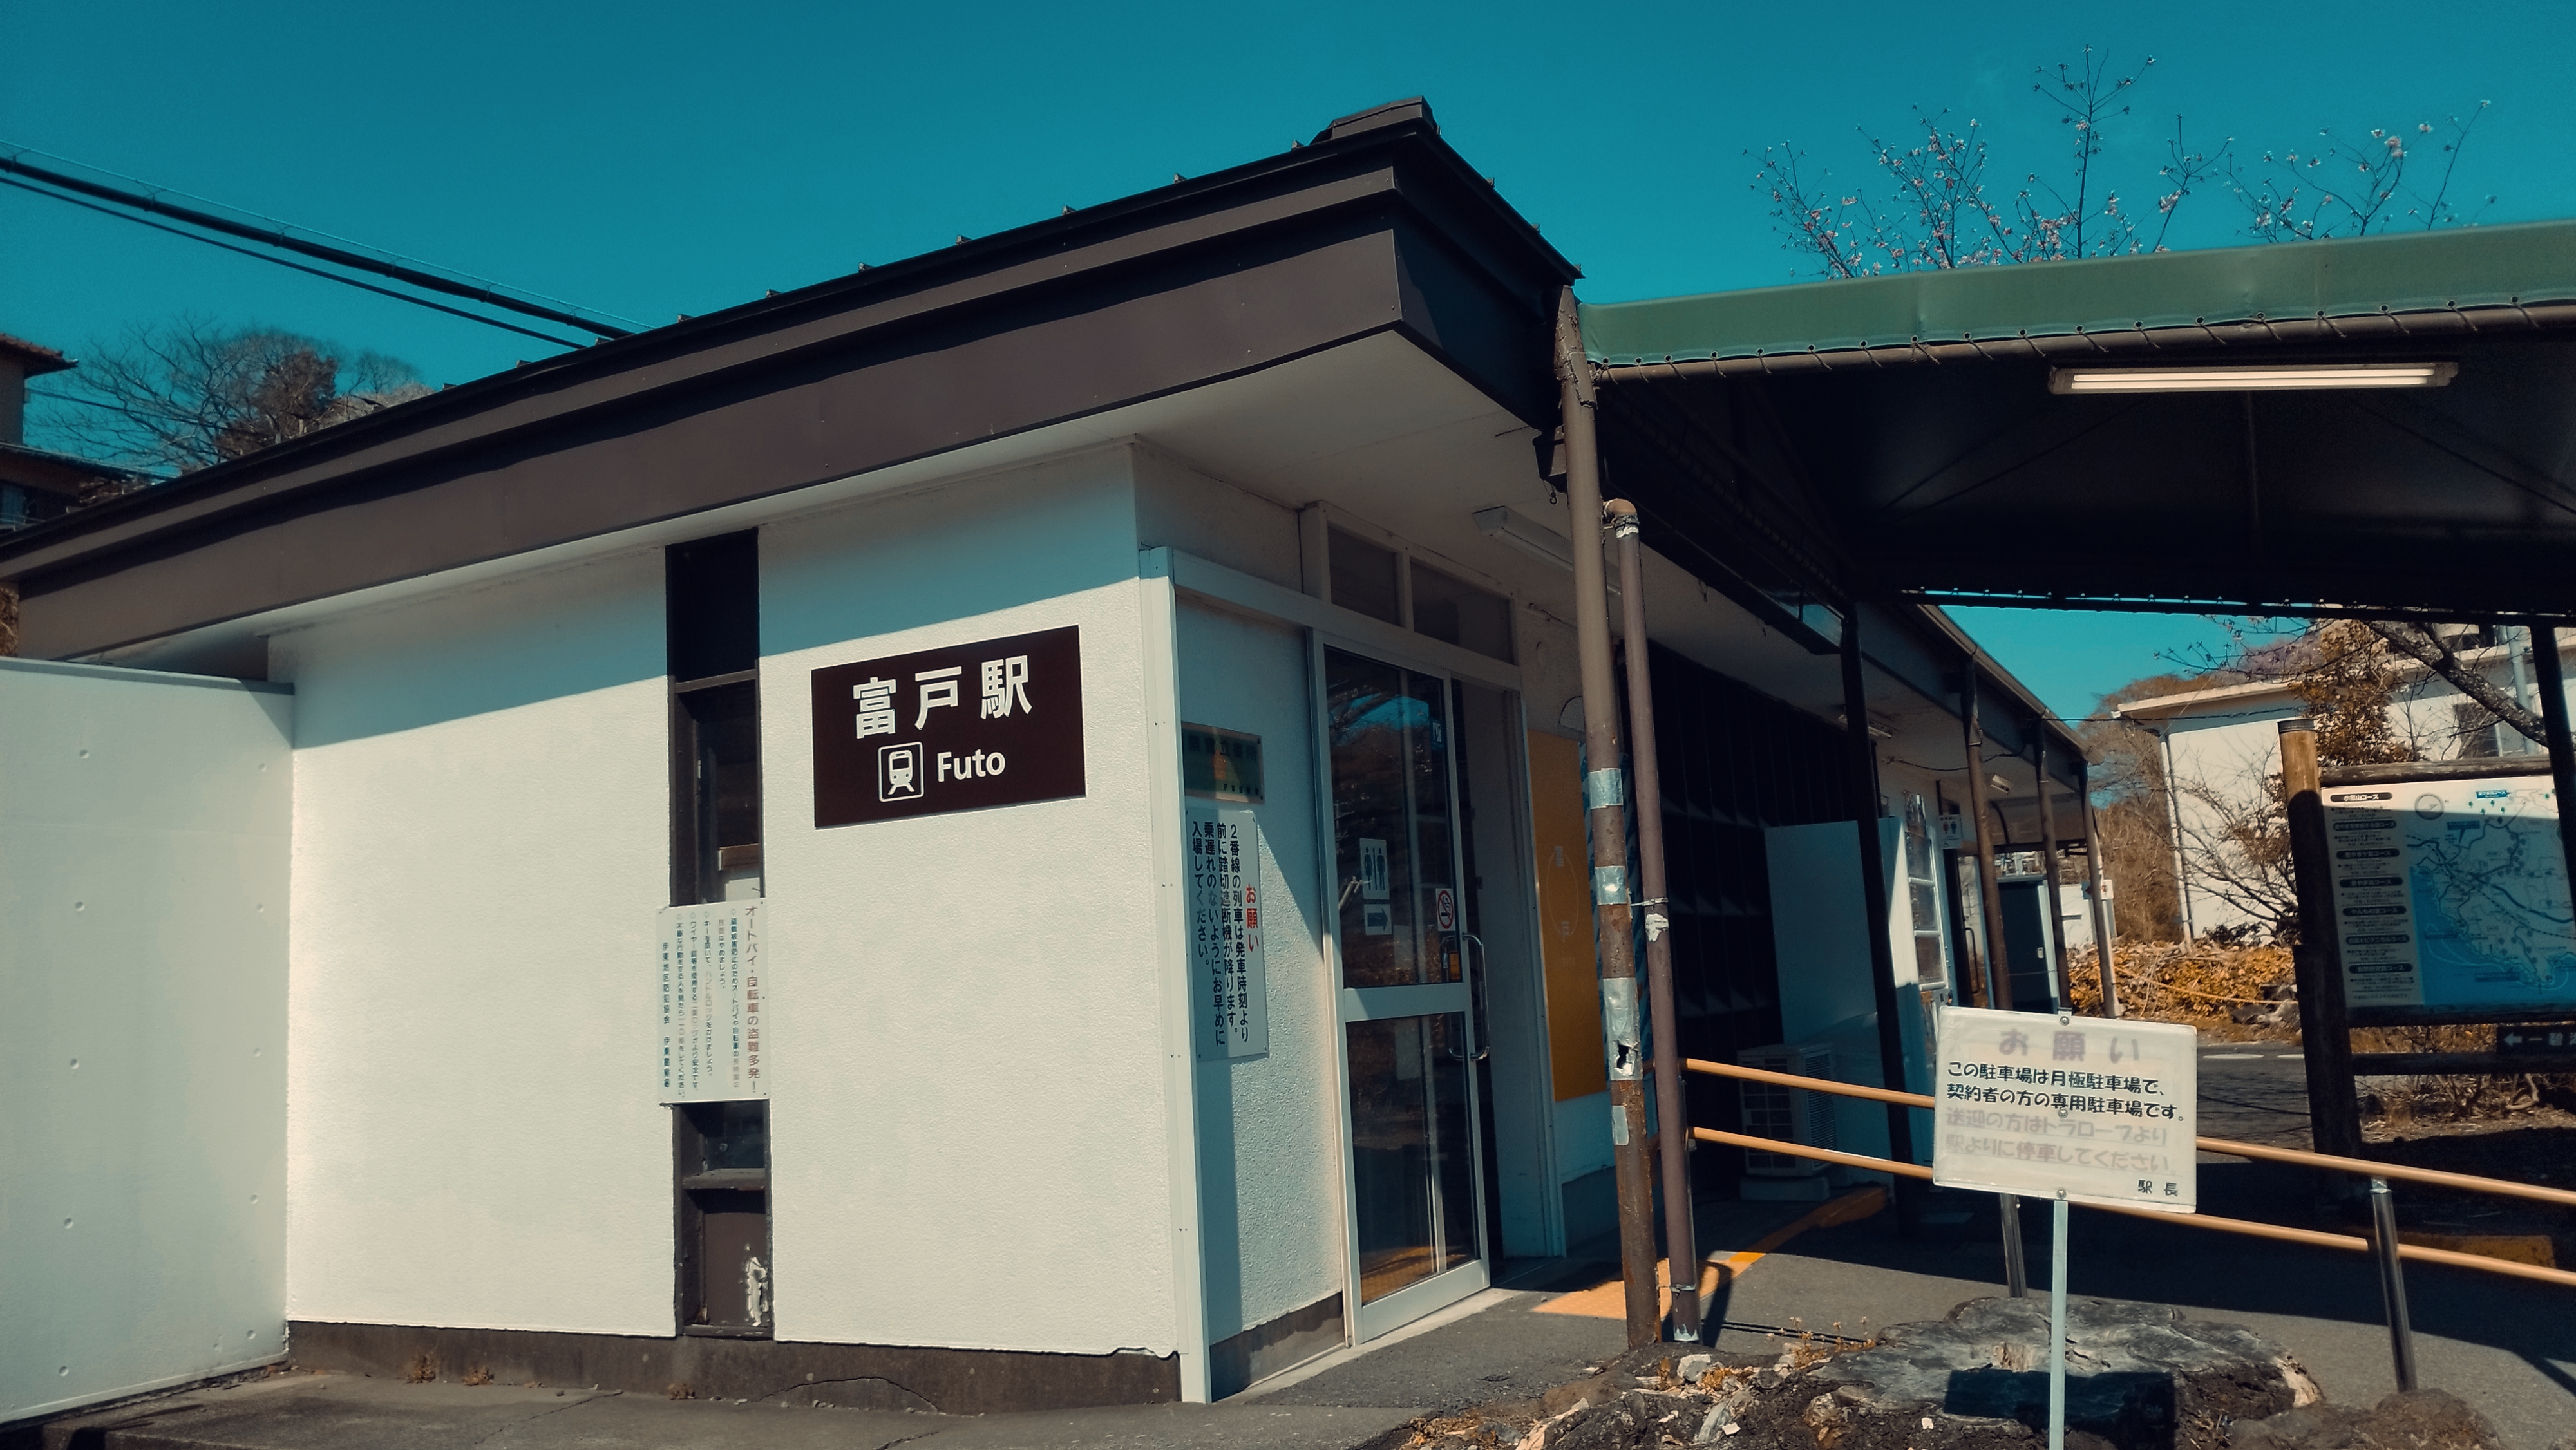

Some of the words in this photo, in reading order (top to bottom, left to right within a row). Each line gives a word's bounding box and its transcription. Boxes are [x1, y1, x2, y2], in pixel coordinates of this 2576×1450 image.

[853, 655, 1032, 740] 富戸駅
[938, 748, 1006, 782] Futo
[1191, 820, 1210, 966] 入場してください。
[1245, 885, 1260, 952] お願い
[1204, 821, 1226, 1046] 乗遅れのないようにお早めに
[1217, 822, 1239, 1033] 前に踏切遮断機が降ります。
[1229, 824, 1249, 1044] 2番線の列車は発車時刻より
[1947, 1061, 2165, 1096] この駐車場は月極駐車場で、
[1998, 1028, 2139, 1064] お願い
[1947, 1082, 2184, 1122] 契約者の方の専用駐車場です。
[2137, 1180, 2179, 1198] 駅長
